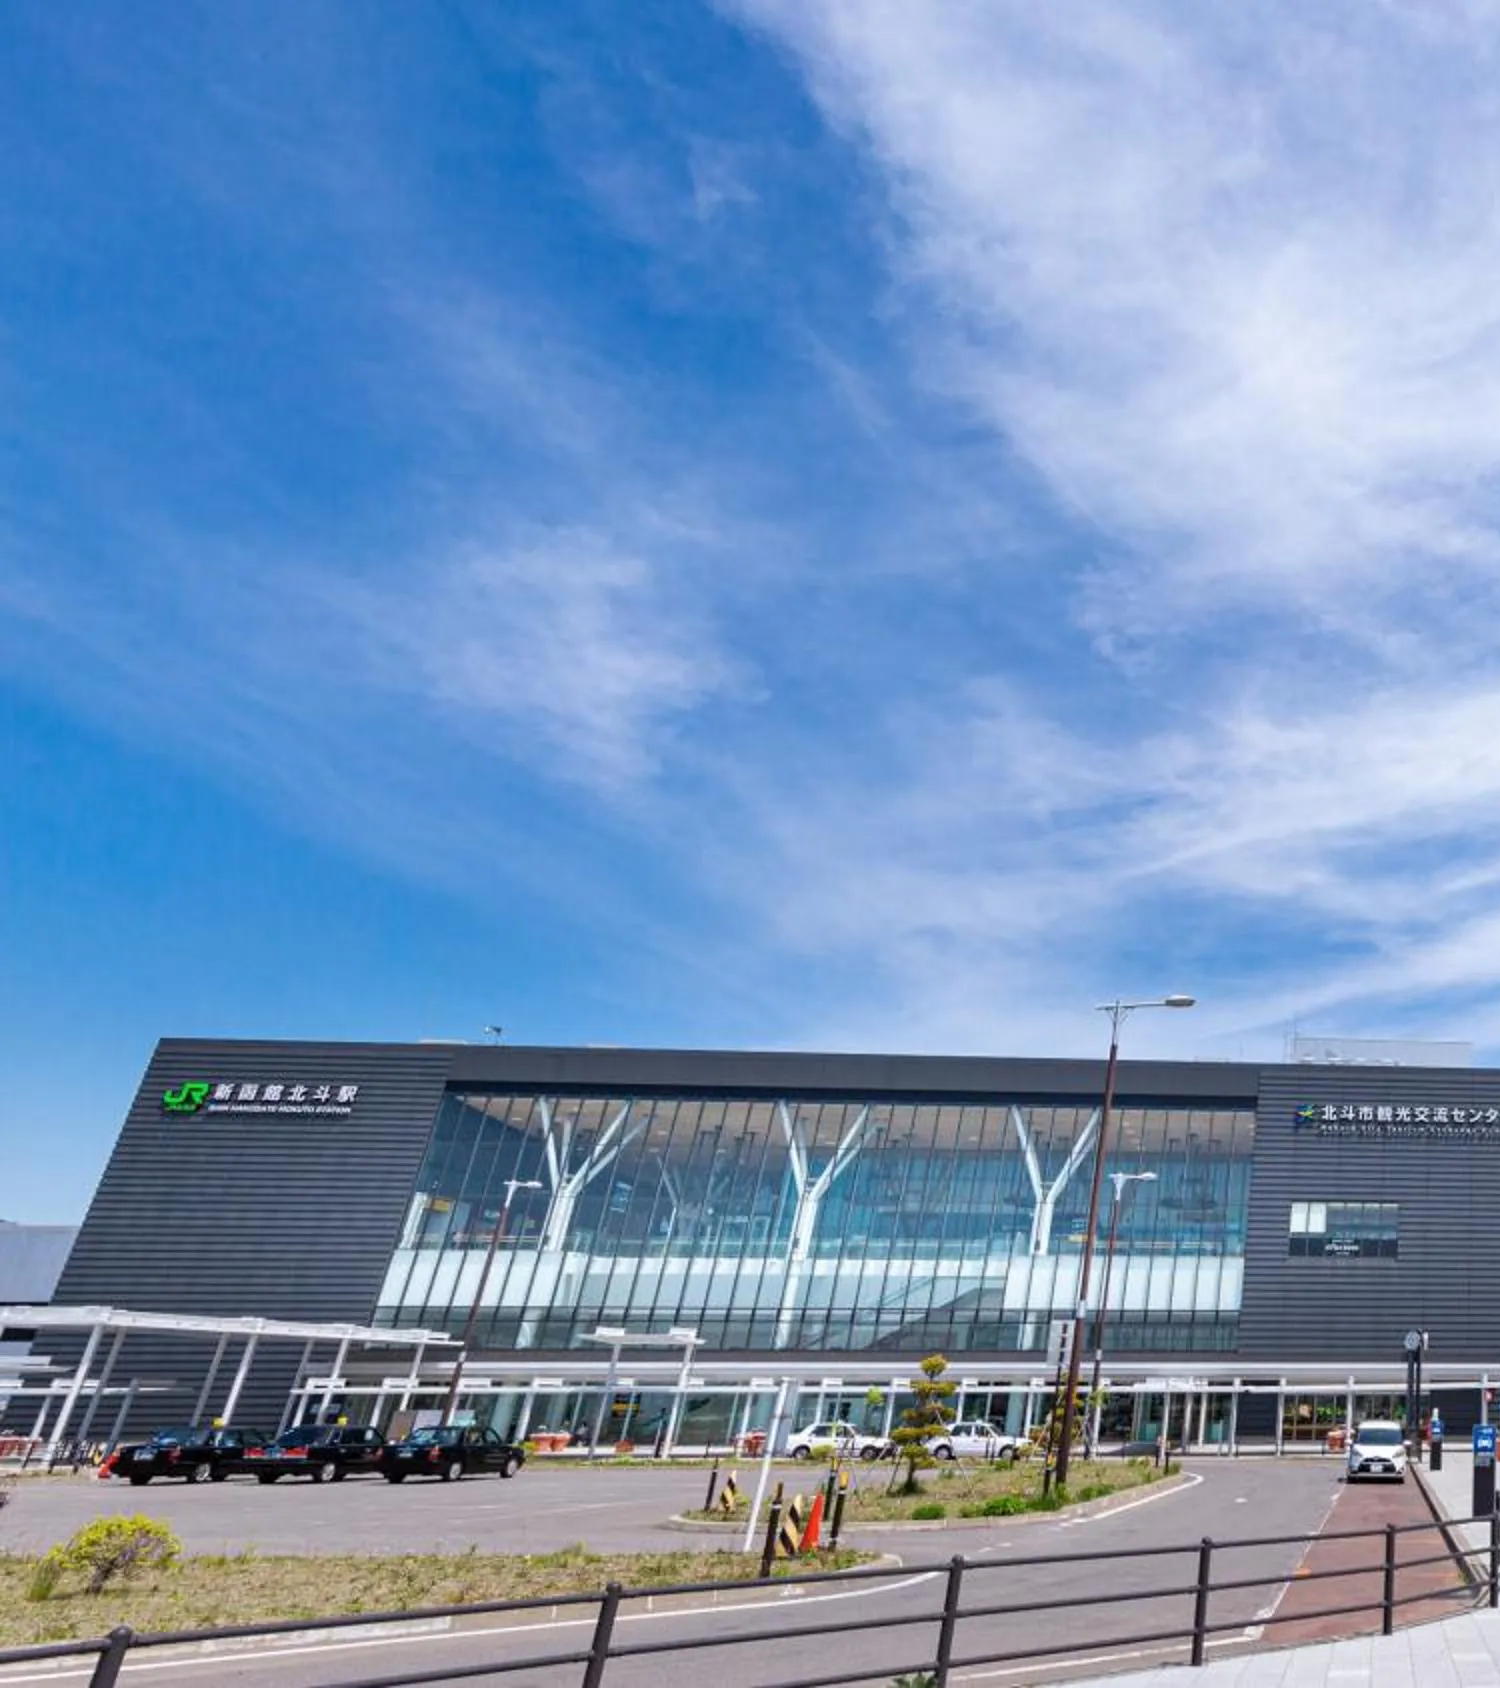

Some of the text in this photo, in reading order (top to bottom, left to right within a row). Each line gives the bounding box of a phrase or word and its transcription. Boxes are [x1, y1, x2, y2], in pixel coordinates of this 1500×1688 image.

[163, 1083, 209, 1103] JR
[213, 1083, 358, 1103] 新函館北斗駅
